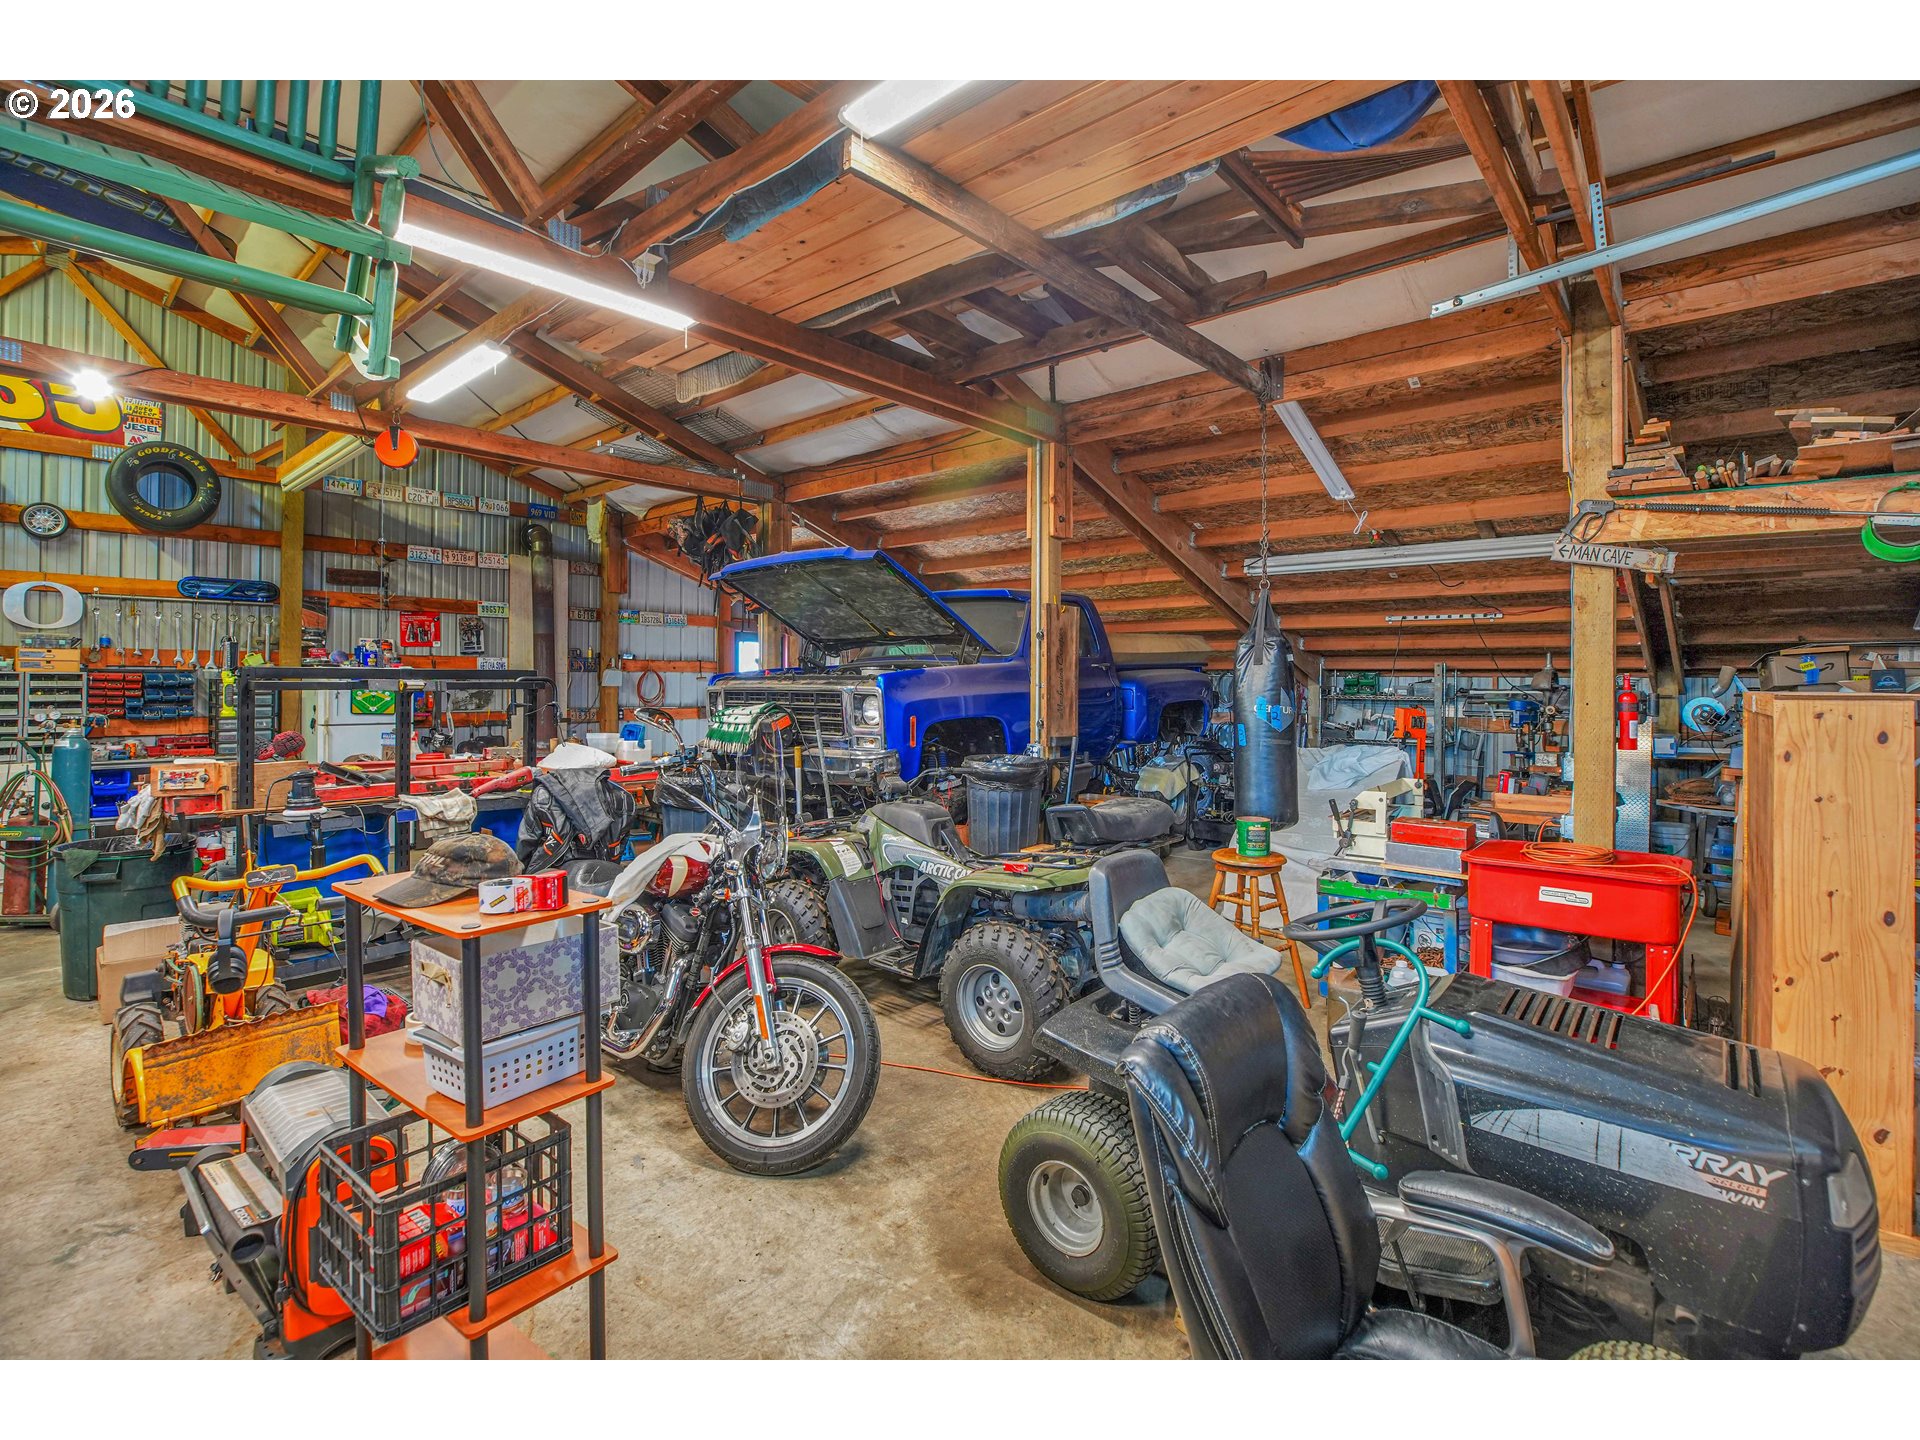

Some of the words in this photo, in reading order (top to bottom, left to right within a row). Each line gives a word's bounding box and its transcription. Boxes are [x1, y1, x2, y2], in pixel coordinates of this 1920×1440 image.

[124, 423, 160, 433] JESEL
[1568, 544, 1601, 562] MAN
[1602, 548, 1634, 566] CAVE
[419, 852, 446, 868] TIHL
[919, 861, 954, 879] ARCTIC
[1668, 1142, 1788, 1187] RRAY
[1718, 1189, 1766, 1210] WIN
